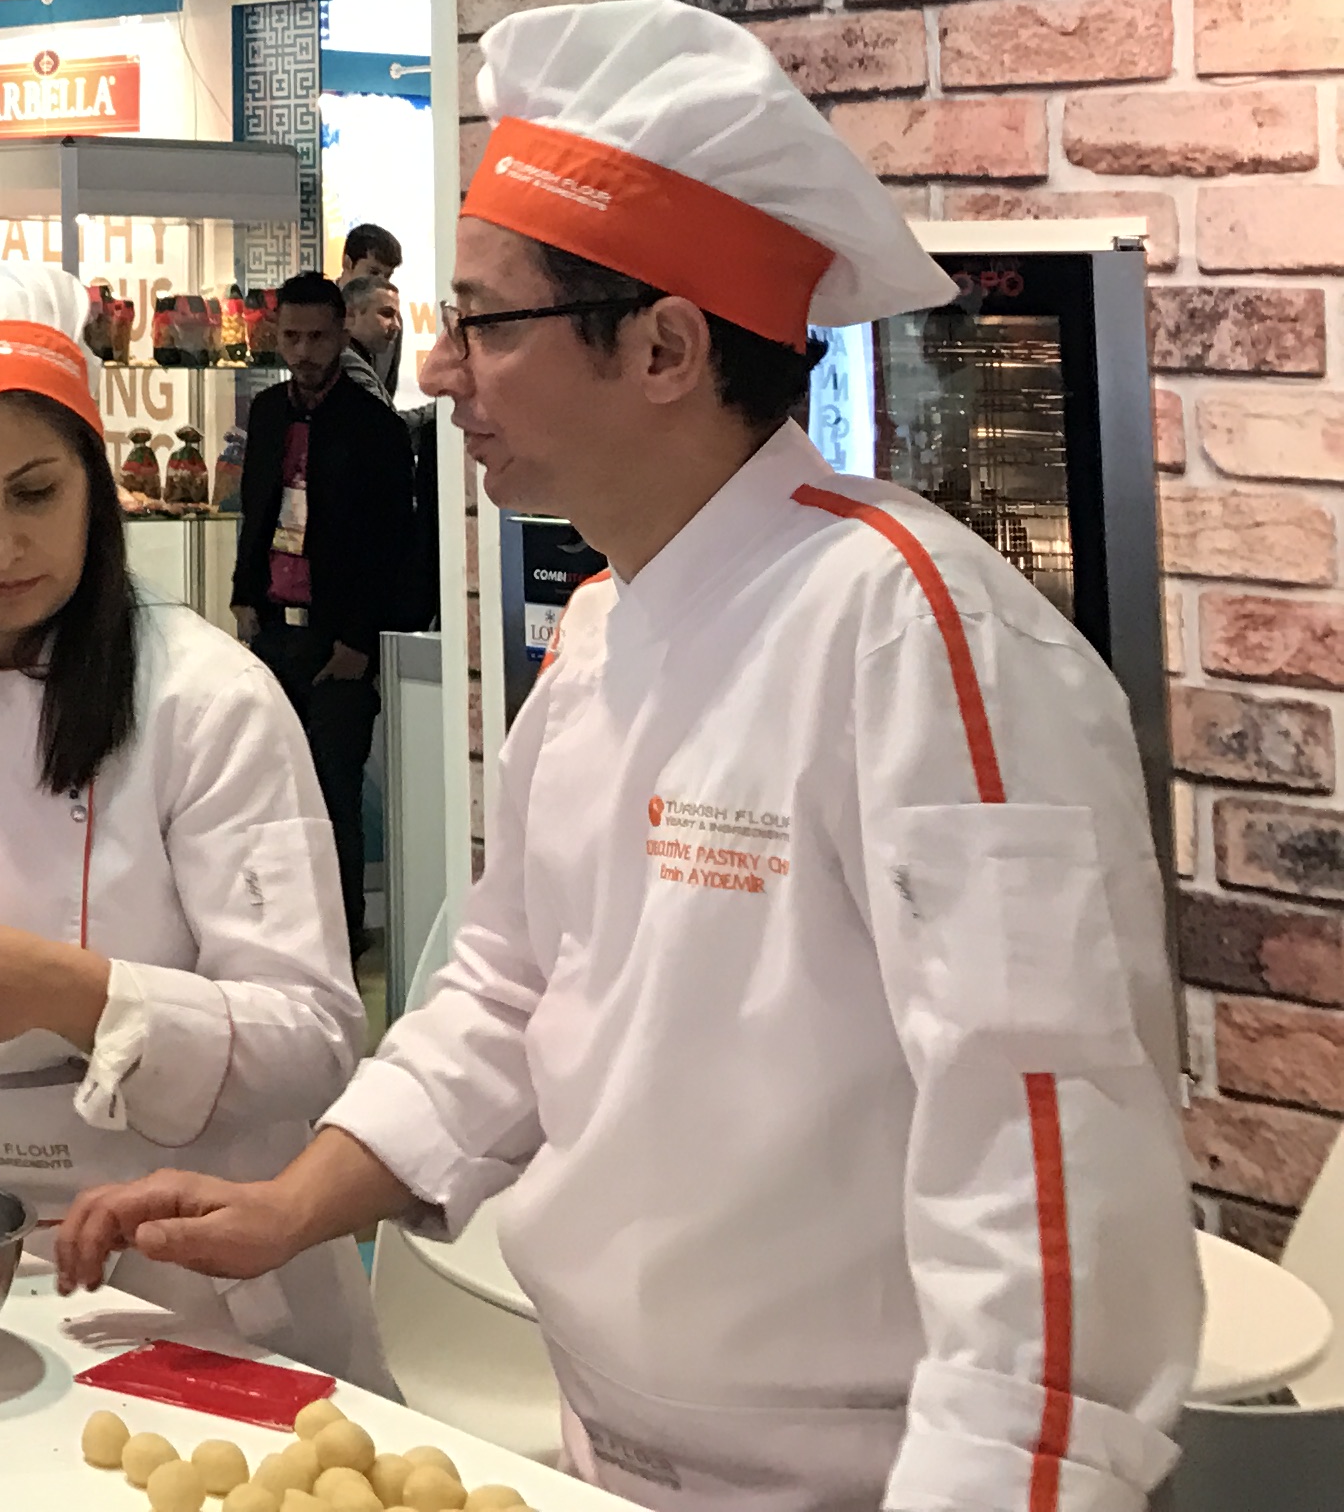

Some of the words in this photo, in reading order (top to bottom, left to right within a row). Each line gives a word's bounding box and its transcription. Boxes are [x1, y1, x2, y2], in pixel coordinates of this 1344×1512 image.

[665, 800, 728, 821] TURKISH
[696, 846, 761, 871] PASTRY
[4, 1142, 70, 1158] FLOUR
